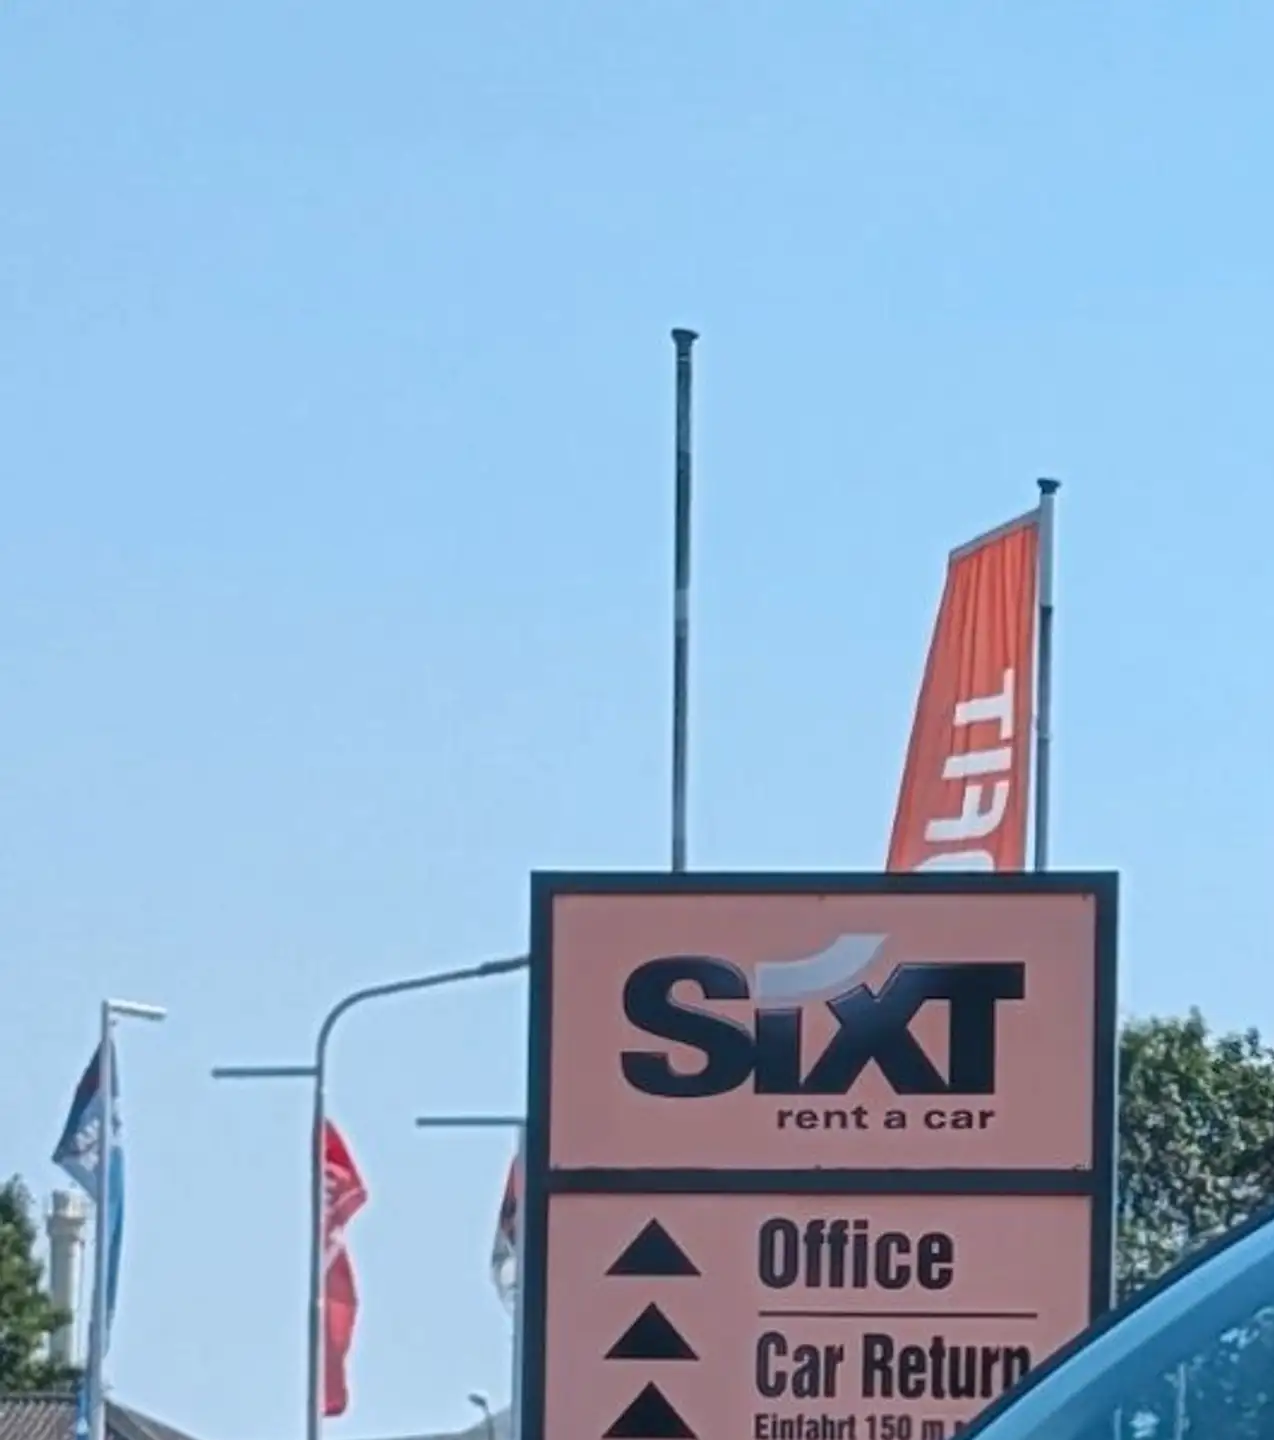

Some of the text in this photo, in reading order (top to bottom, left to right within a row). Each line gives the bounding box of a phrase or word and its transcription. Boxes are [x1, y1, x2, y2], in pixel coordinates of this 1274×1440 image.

[776, 1108, 997, 1130] rent a car
[757, 1218, 954, 1290] Office
[755, 1331, 1031, 1400] Car Return
[921, 1419, 945, 1440] m
